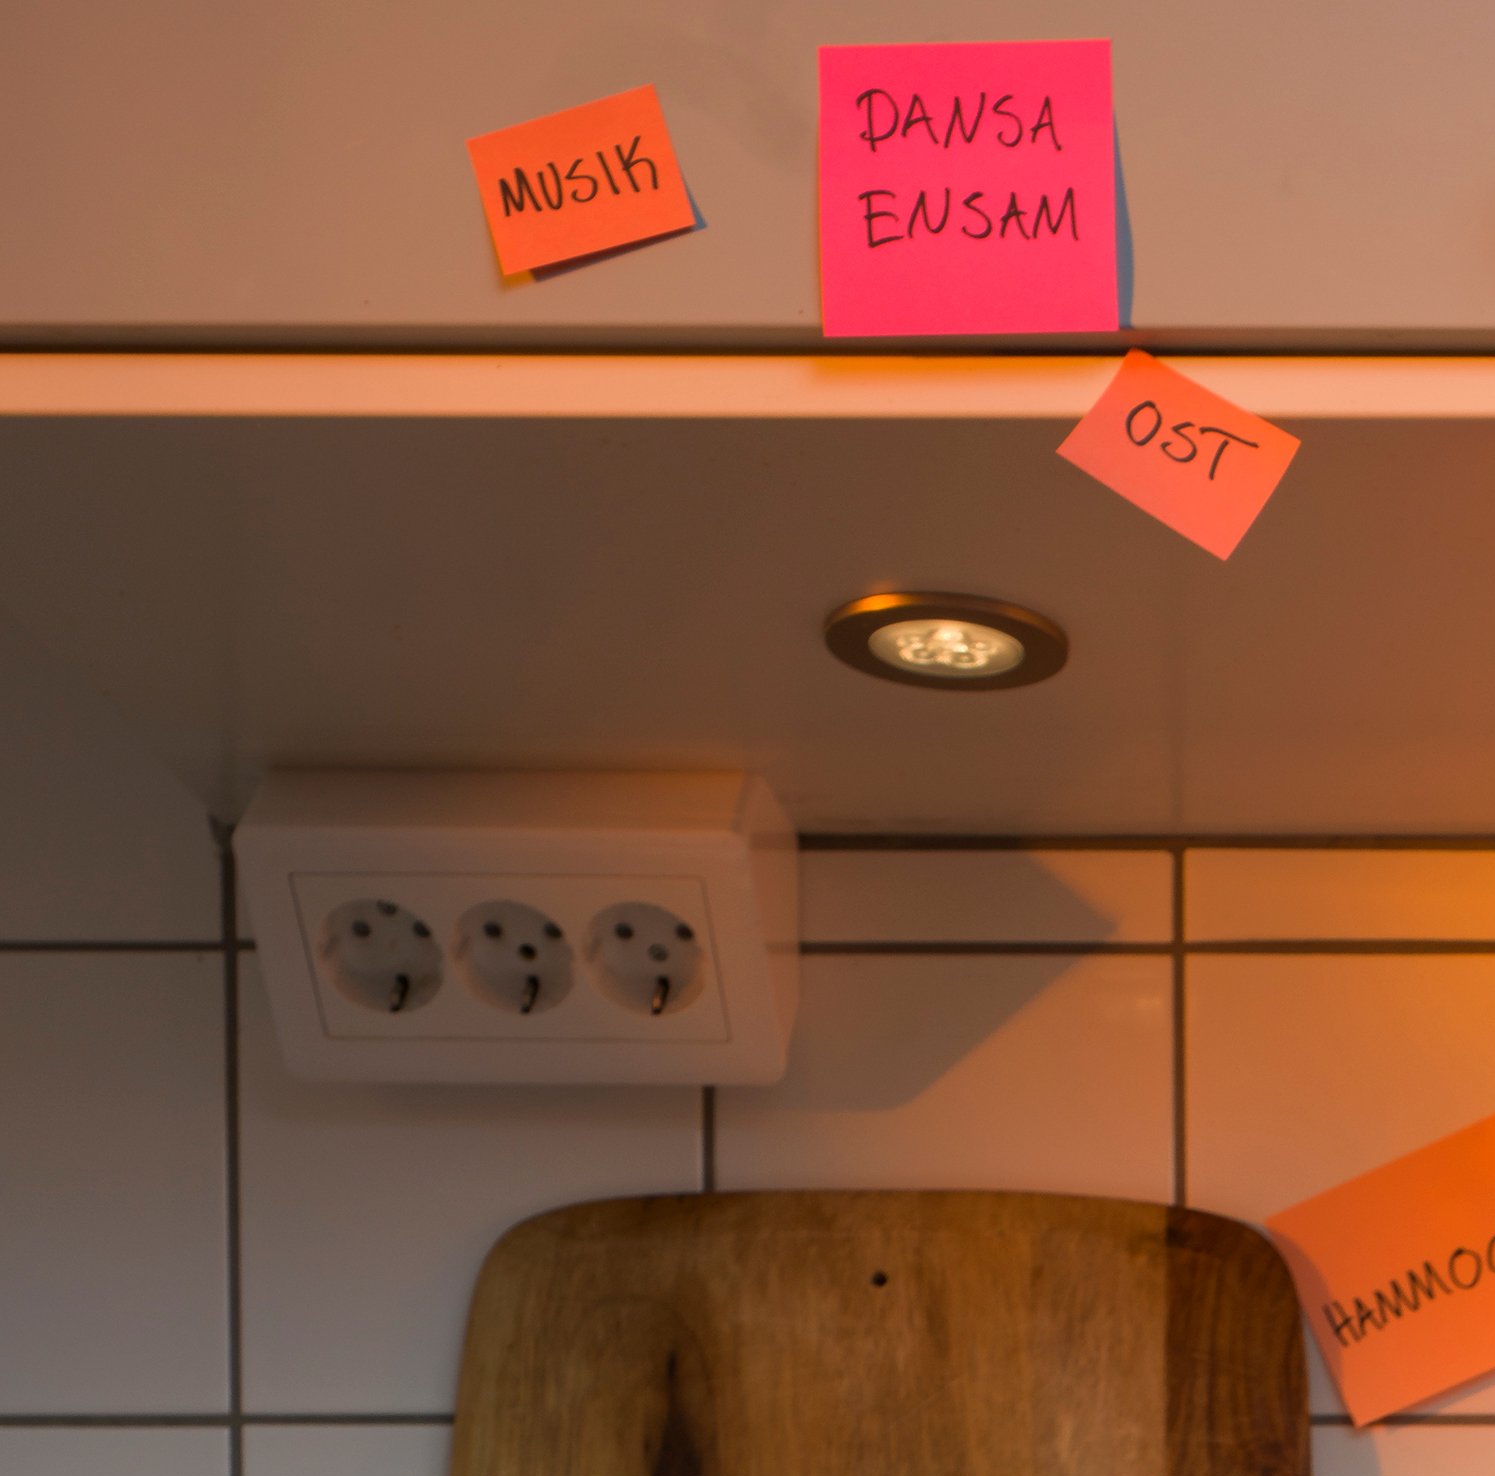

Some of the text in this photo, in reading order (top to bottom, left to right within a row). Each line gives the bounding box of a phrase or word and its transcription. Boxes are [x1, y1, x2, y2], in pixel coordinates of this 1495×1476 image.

[856, 88, 1062, 152] DANSA
[498, 135, 660, 218] MUSIK
[860, 188, 1080, 250] ENSAM
[1125, 401, 1258, 480] OST
